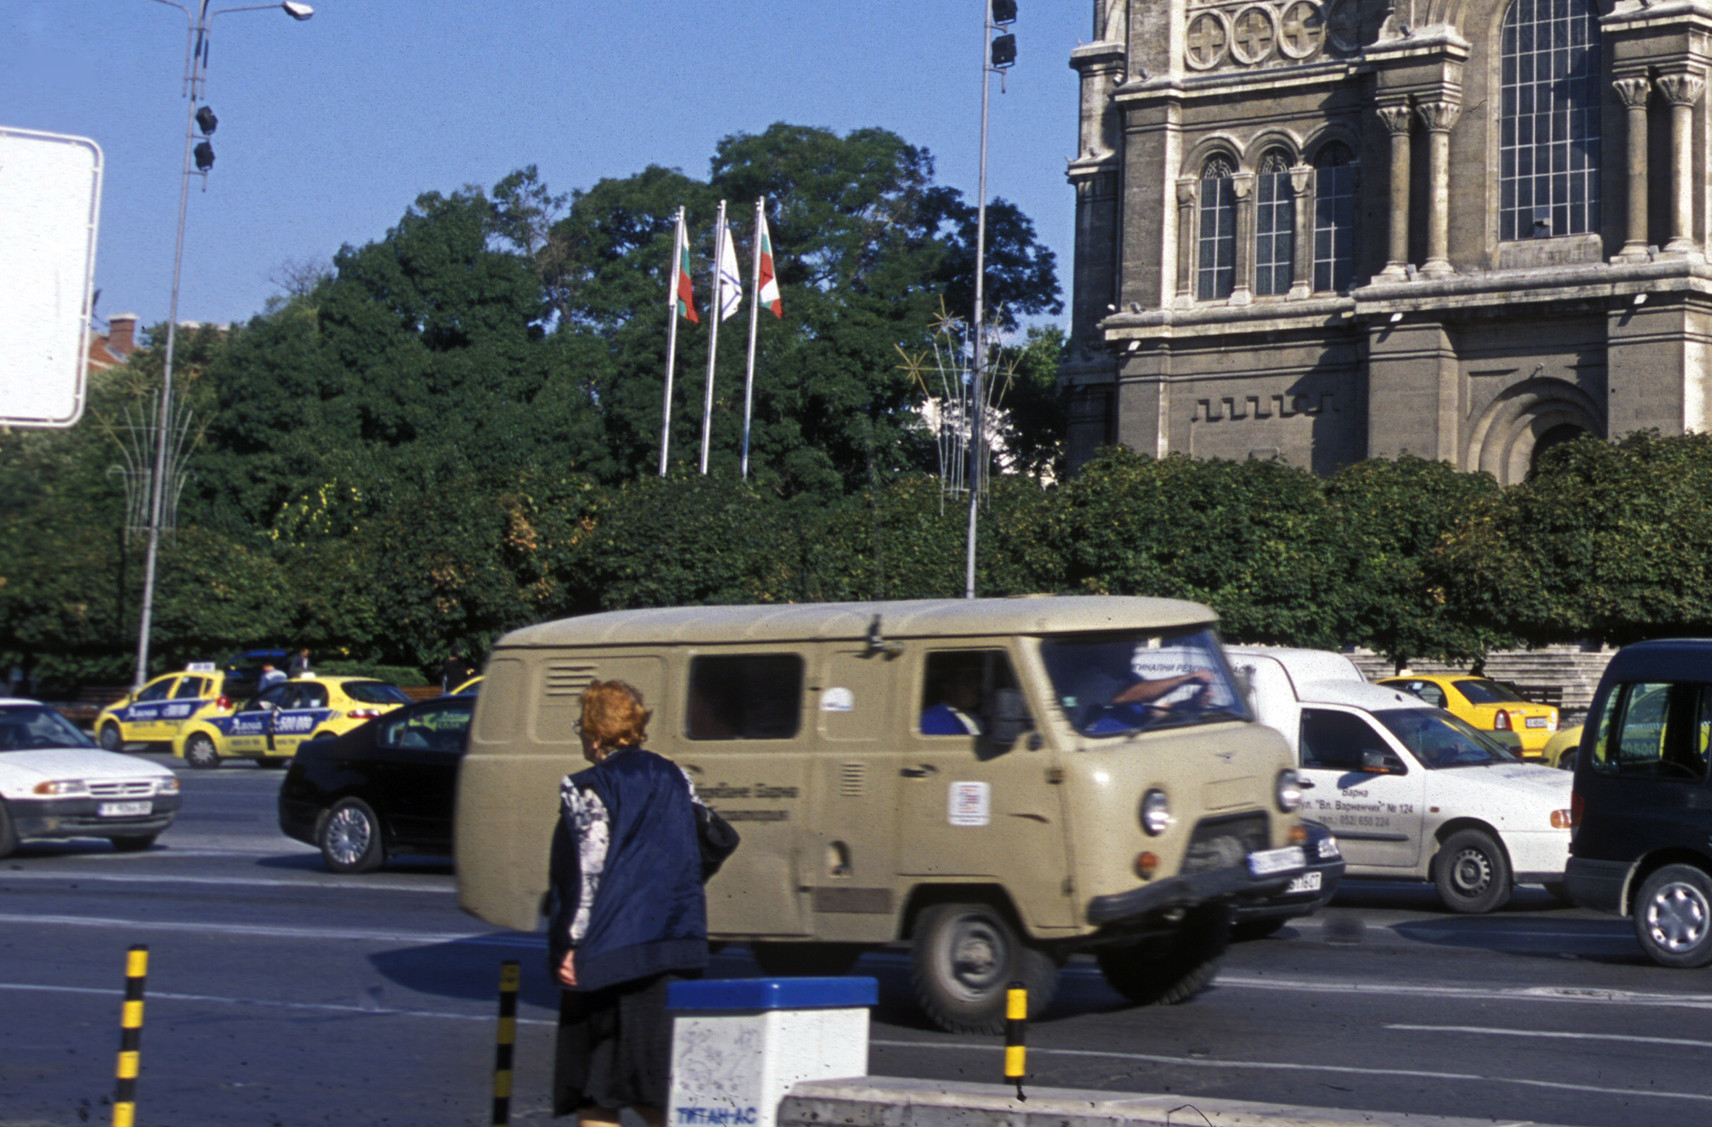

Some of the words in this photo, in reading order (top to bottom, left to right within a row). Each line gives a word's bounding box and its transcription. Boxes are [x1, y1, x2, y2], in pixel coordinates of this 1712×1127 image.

[1341, 788, 1369, 798] Варна
[1399, 803, 1414, 814] 124
[1375, 816, 1390, 827] 224
[676, 1107, 757, 1124] ТИТАН-АС
